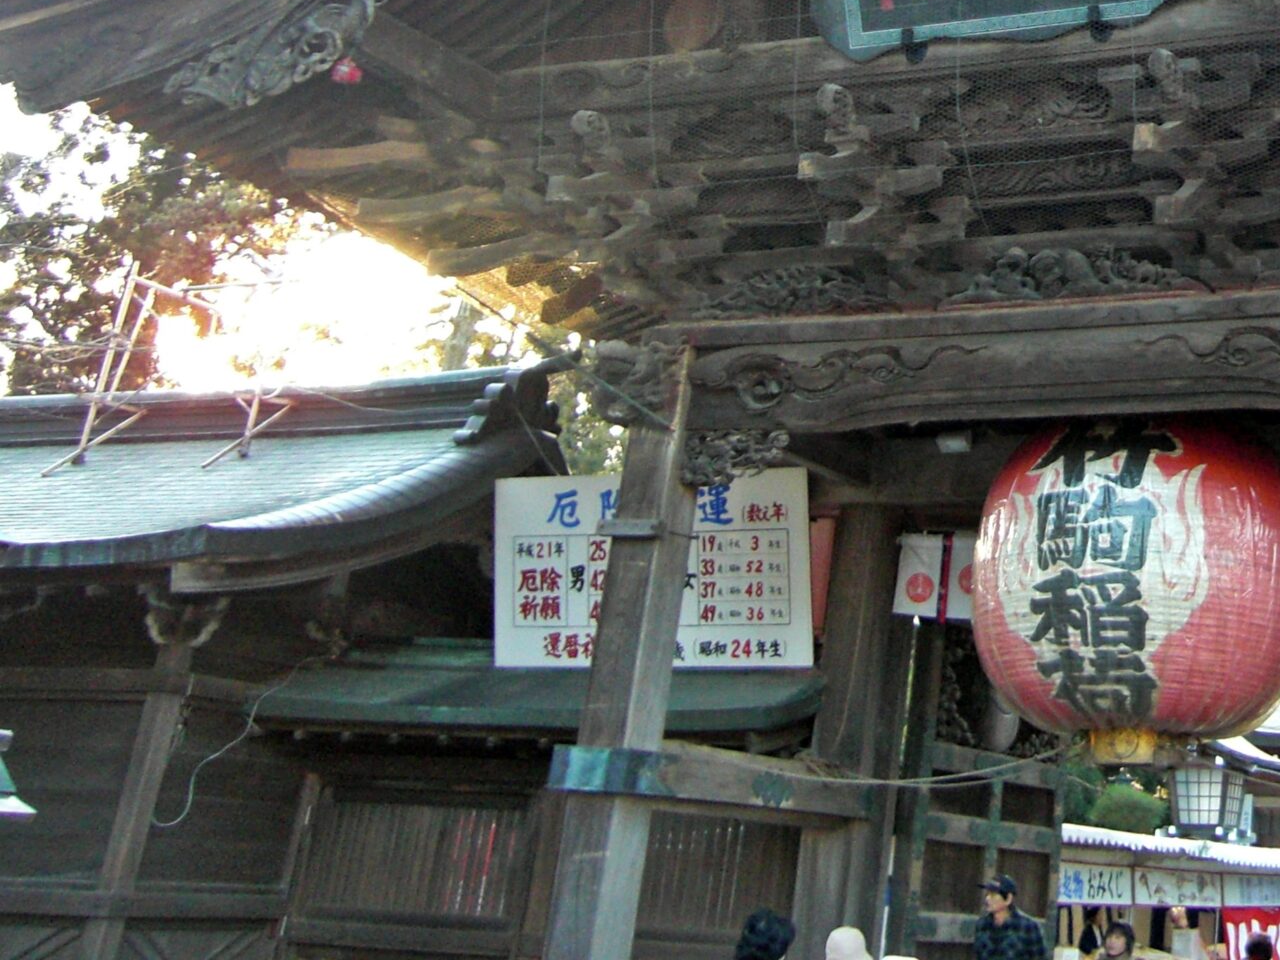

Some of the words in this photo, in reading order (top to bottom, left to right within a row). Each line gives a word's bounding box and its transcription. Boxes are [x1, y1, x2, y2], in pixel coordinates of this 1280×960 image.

[516, 541, 565, 559] 平成21年
[589, 540, 607, 561] 25
[517, 567, 563, 593] 厄除
[569, 564, 586, 592] 男
[519, 595, 562, 622] 祈願
